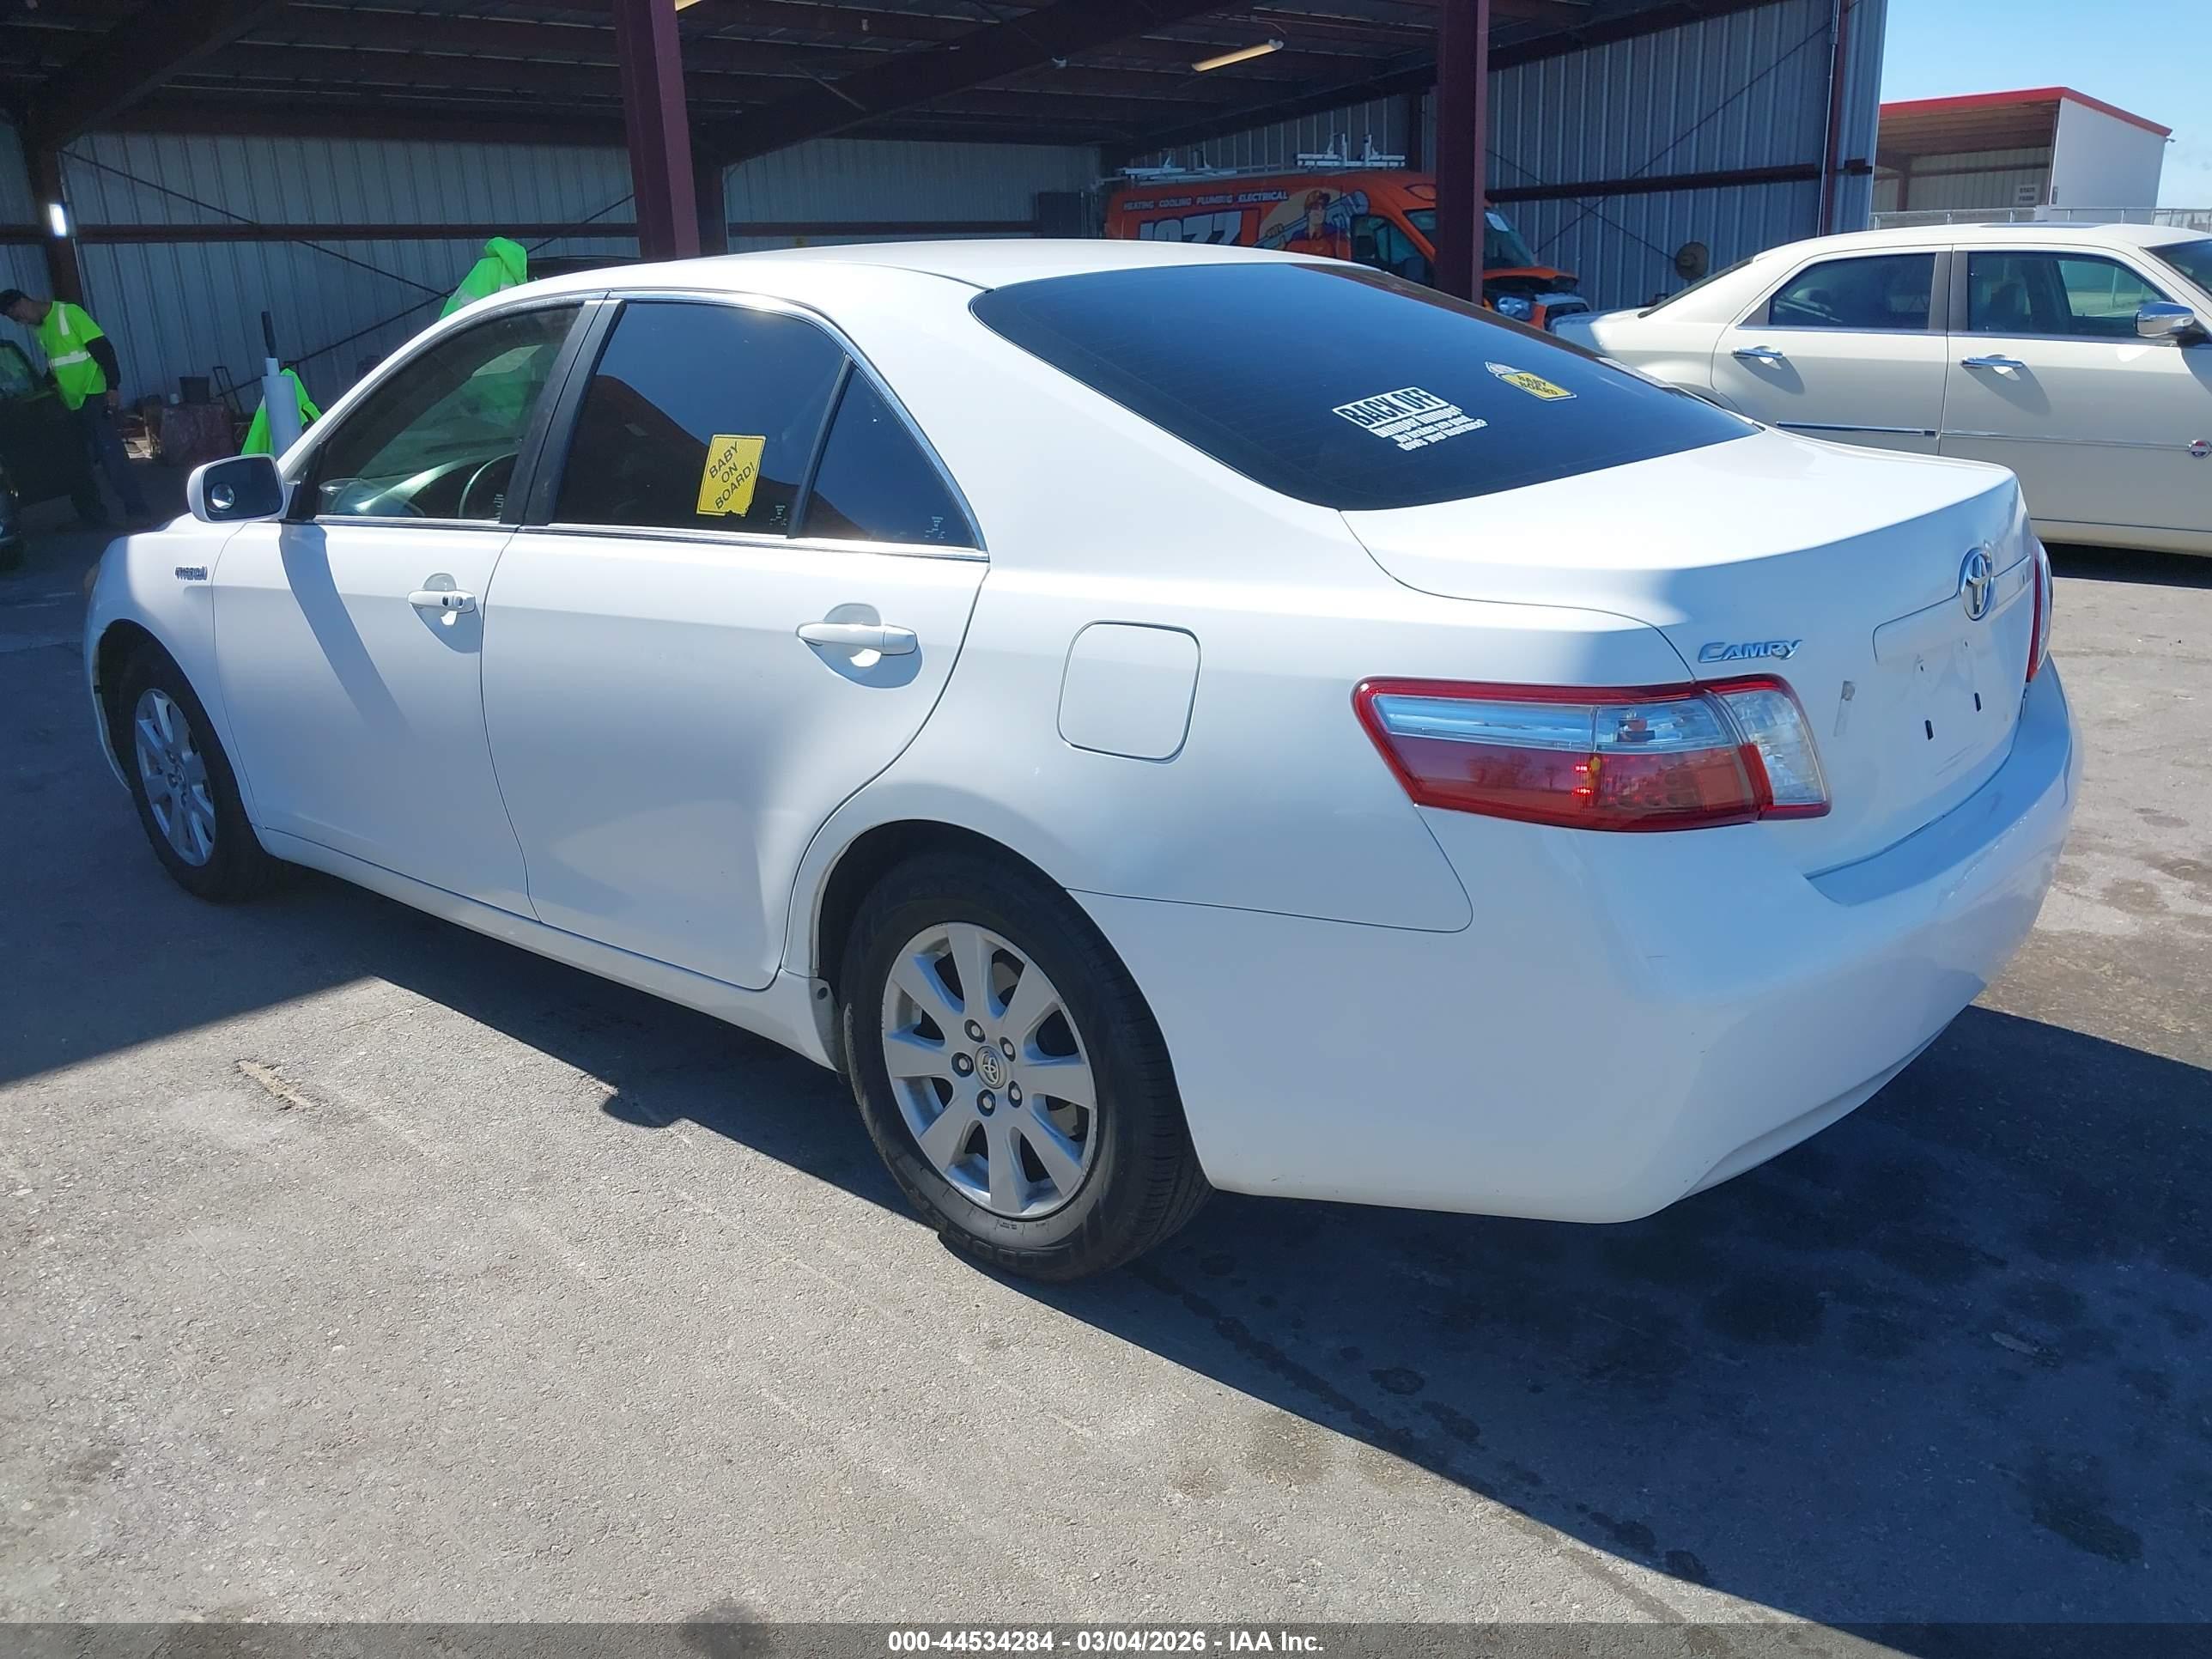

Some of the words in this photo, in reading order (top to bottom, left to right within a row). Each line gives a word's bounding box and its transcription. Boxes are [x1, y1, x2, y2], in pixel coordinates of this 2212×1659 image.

[1124, 200, 1154, 210] HEATING
[1159, 198, 1191, 208] COOLING
[1238, 191, 1287, 203] ELECTRICAL
[1337, 396, 1413, 426] BACK
[1390, 389, 1441, 410] OFF
[708, 441, 738, 479] BABY
[721, 462, 738, 483] ON
[714, 461, 755, 509] BOARD!
